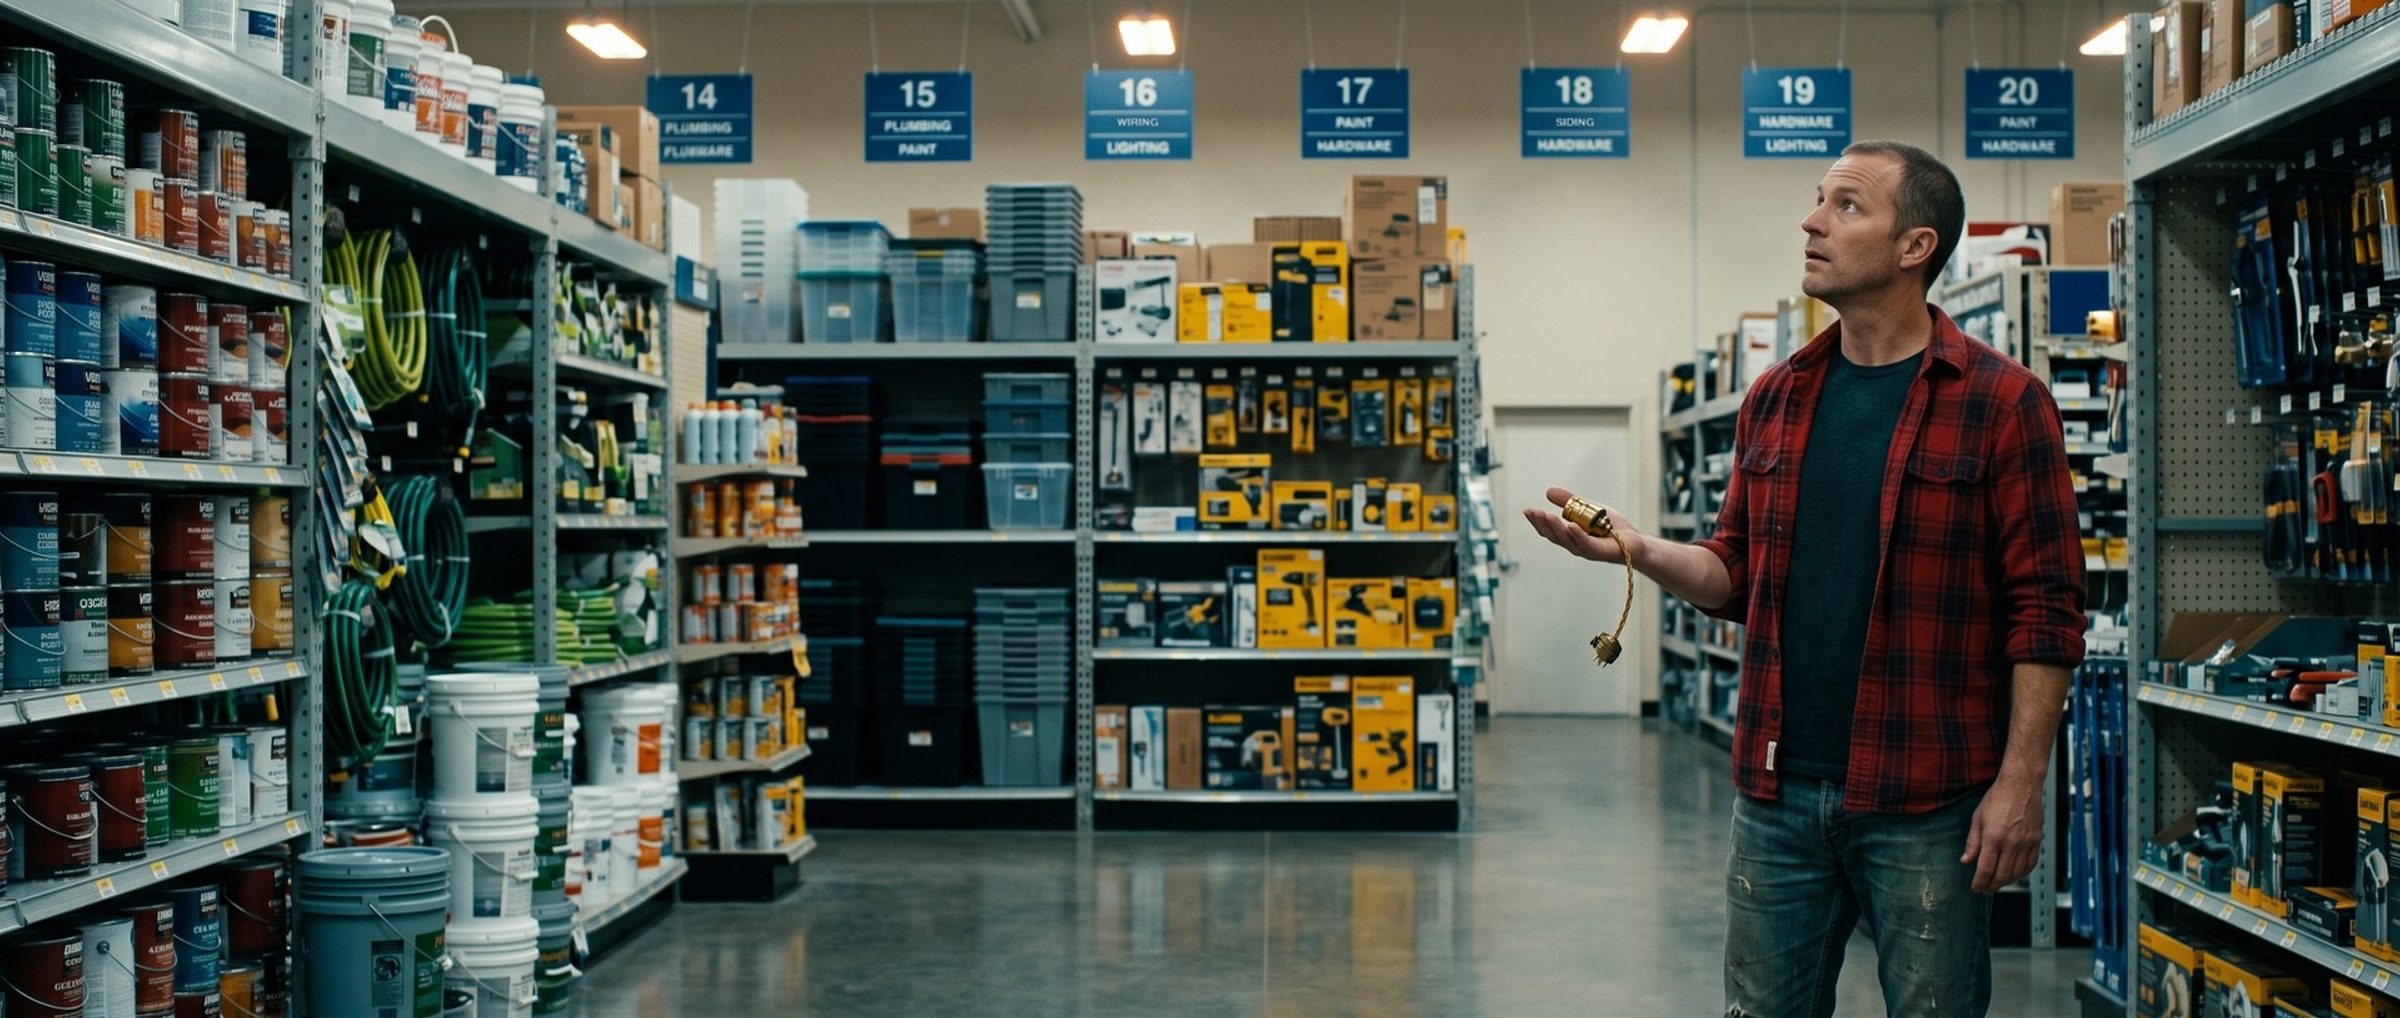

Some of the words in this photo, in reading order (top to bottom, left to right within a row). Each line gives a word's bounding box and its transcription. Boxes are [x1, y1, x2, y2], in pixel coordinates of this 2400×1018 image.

[681, 82, 718, 110] 14
[900, 80, 937, 108] 15
[1119, 77, 1158, 107] 16
[1336, 77, 1374, 105] 17
[1555, 75, 1594, 105] 18
[1778, 75, 1816, 105] 19
[1998, 76, 2039, 106] 20
[664, 121, 733, 135] PLUMBING
[884, 119, 953, 133] PLUMBING
[1116, 117, 1159, 127] WIRING
[1335, 116, 1374, 129] PAINT
[1555, 117, 1595, 127] SIDING
[1759, 115, 1834, 129] HARDWARE
[1999, 116, 2037, 129] PAINT
[898, 142, 937, 156] PAINT
[1106, 141, 1170, 155] LIGHTING
[1316, 139, 1392, 153] HARDWARE
[1537, 138, 1613, 153] HARDWARE
[1765, 138, 1828, 153] LIGHTING
[1981, 139, 2056, 153] HARDWARE
